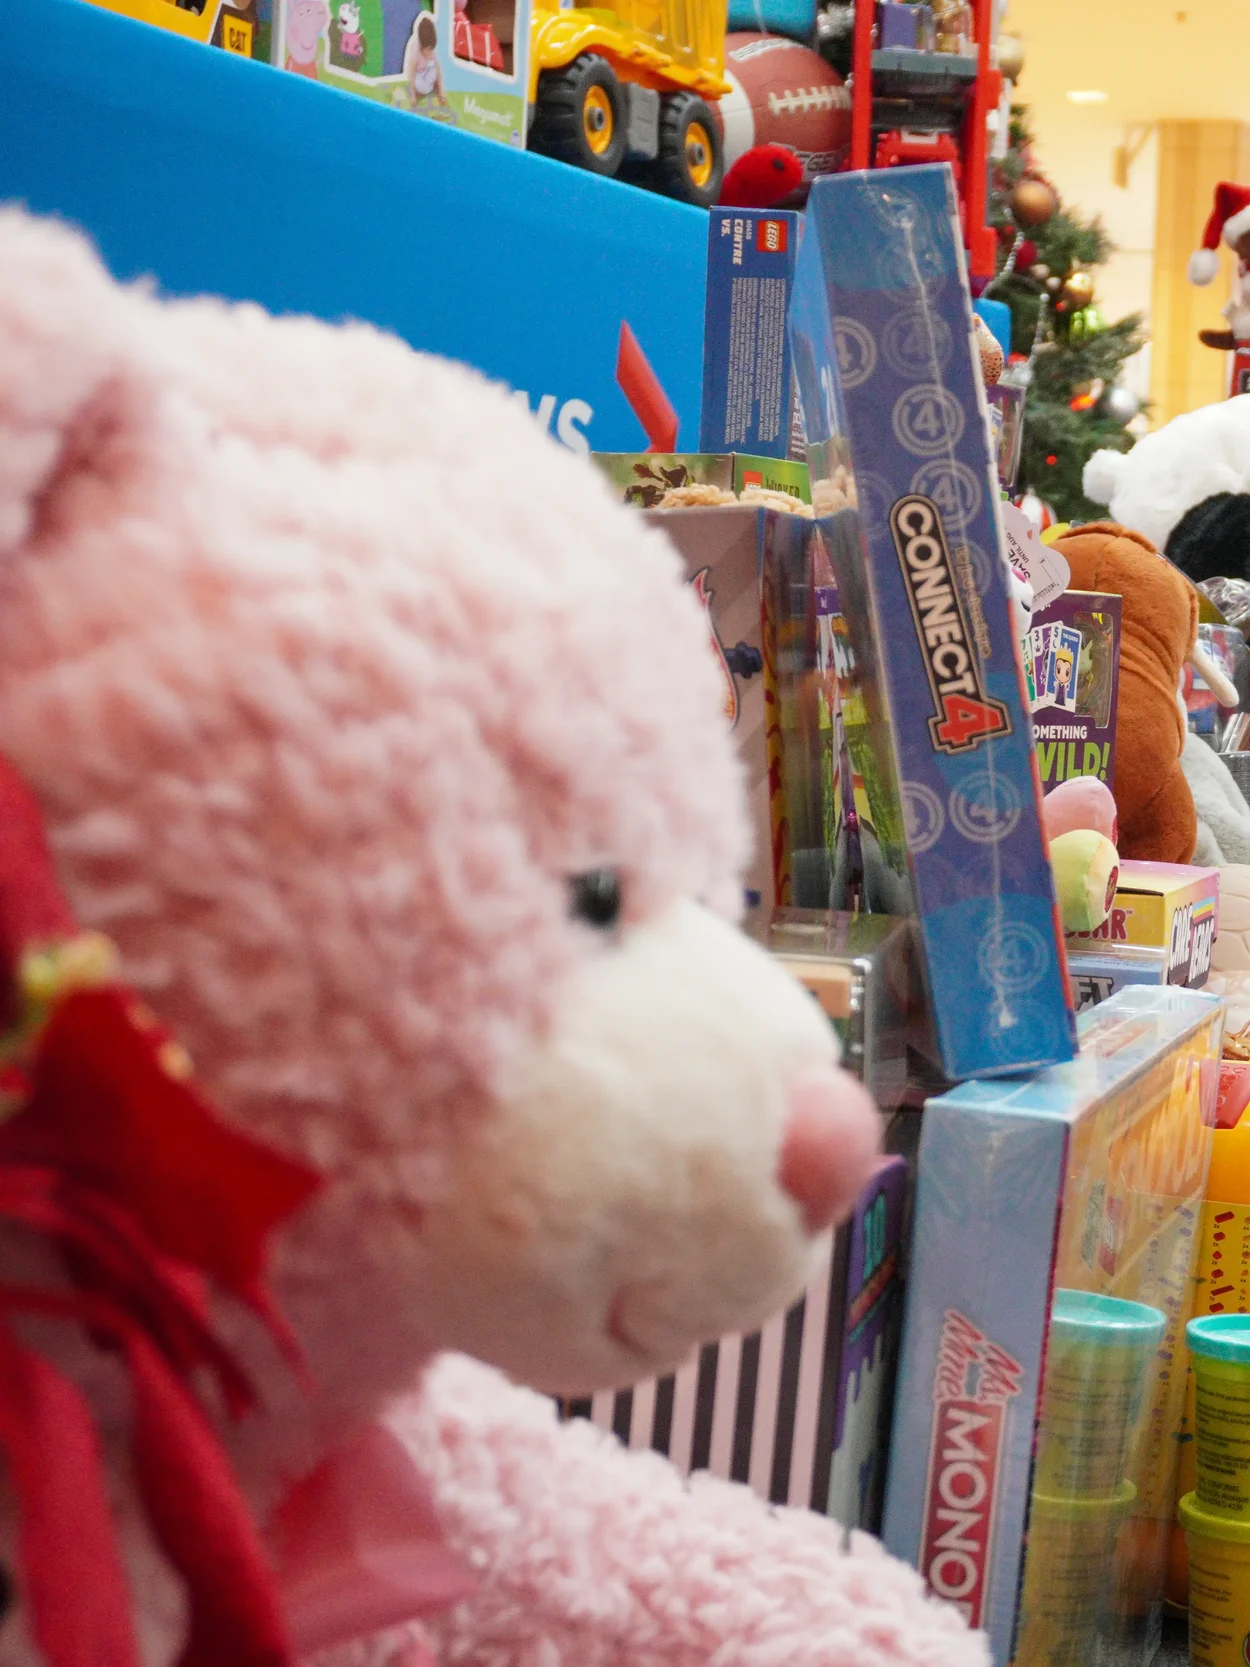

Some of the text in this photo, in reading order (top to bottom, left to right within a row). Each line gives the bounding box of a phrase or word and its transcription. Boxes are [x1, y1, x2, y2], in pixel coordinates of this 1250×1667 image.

[229, 27, 247, 46] CAT
[721, 219, 730, 237] VS.
[766, 220, 779, 251] LEGO
[732, 218, 743, 266] CONTRE
[1016, 546, 1029, 563] UNTIL
[897, 501, 978, 695] CONNECT
[1034, 630, 1040, 641] 3
[1053, 627, 1059, 638] 5
[936, 692, 1004, 745] 4
[1032, 725, 1088, 739] OMETHING
[1170, 902, 1192, 971] CARE
